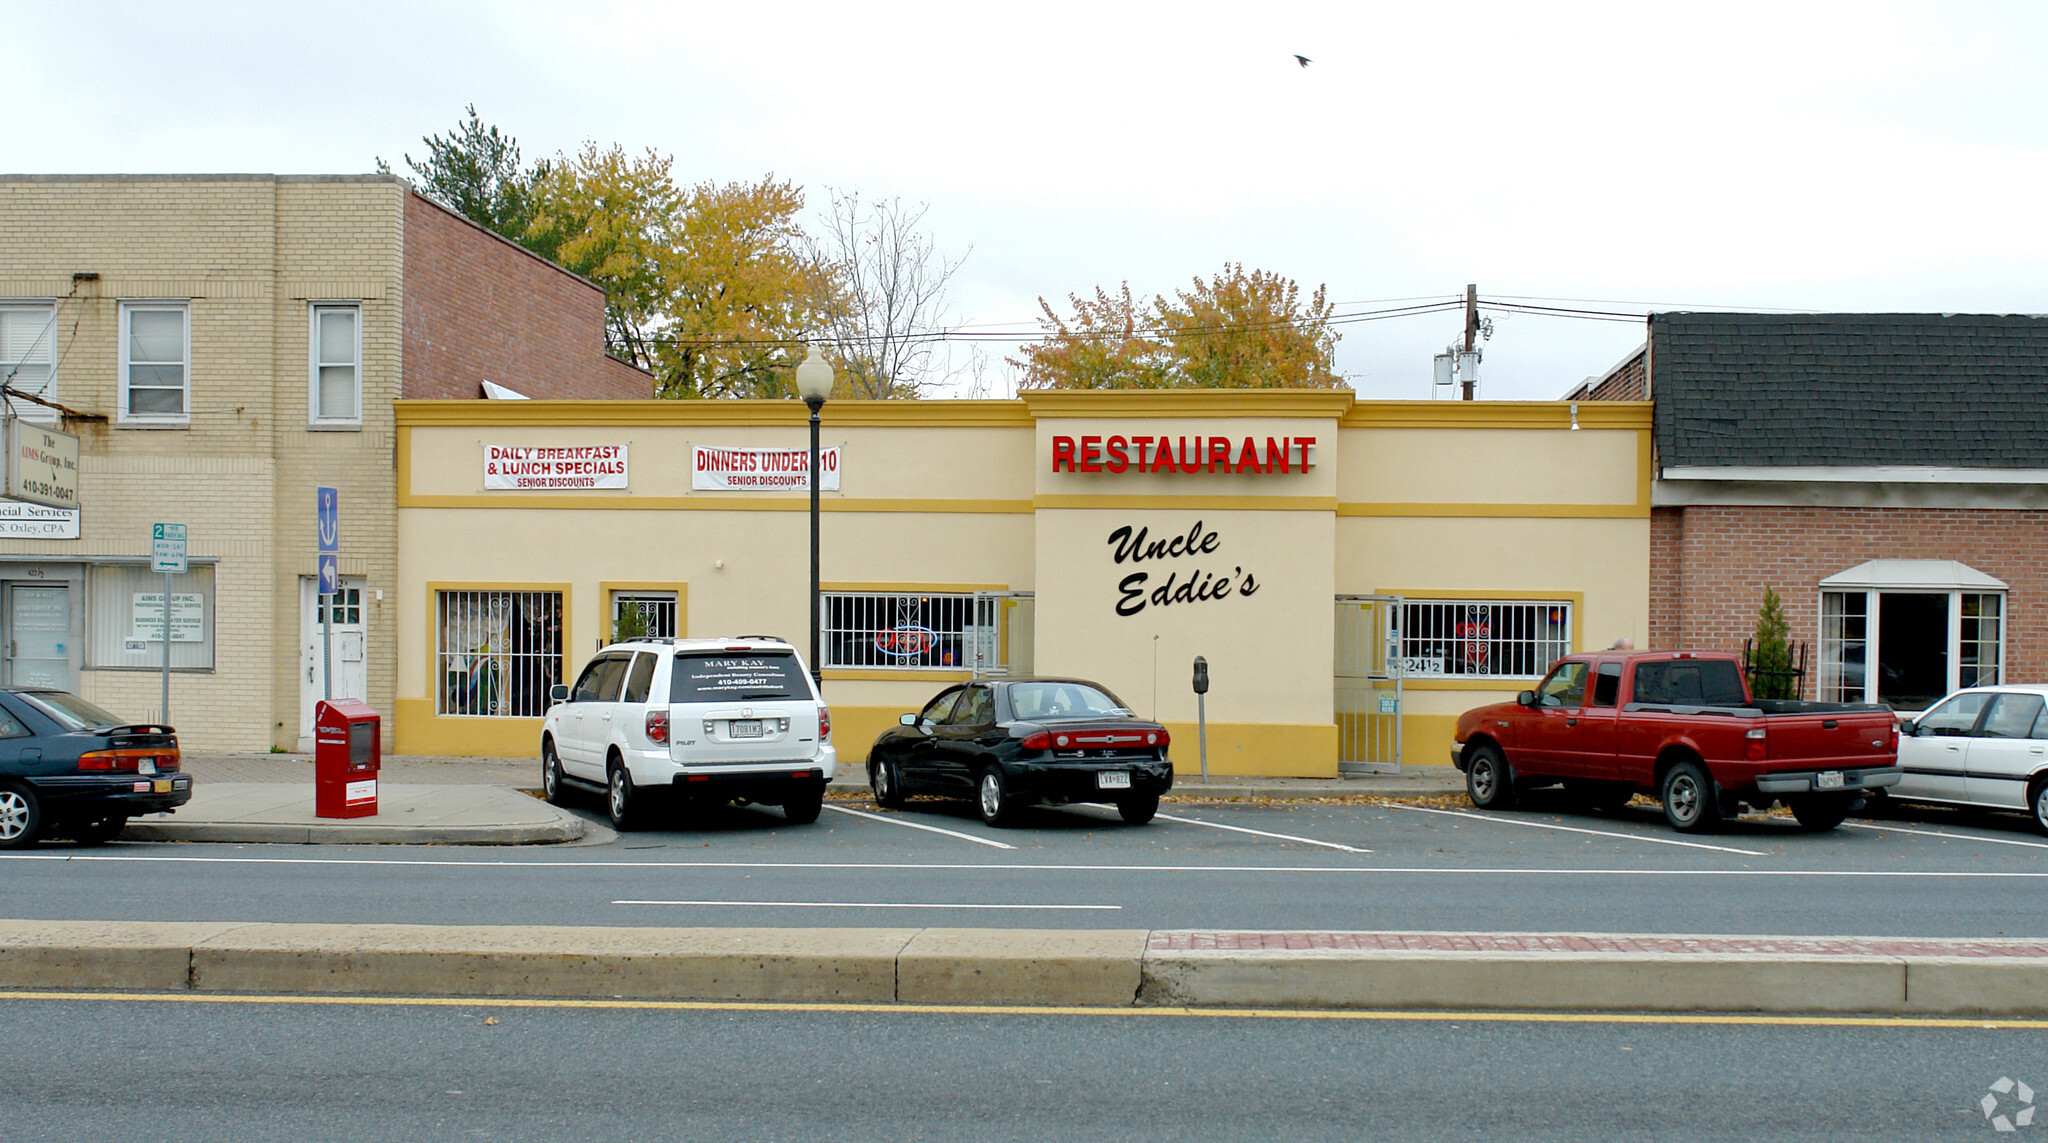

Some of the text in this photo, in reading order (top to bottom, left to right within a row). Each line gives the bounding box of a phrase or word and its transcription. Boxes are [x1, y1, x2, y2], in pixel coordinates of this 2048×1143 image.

[43, 434, 55, 448] The
[21, 445, 39, 461] AIMS
[64, 456, 77, 471] Inc.
[491, 446, 620, 460] DAILY BREAKFAST
[1052, 435, 1316, 474] RESTAURANT
[487, 461, 625, 475] & LUNCH SPECIALS
[697, 450, 837, 472] DINNERS UNDER 10
[517, 477, 595, 487] SENIOR DISCOUNTS
[727, 475, 807, 486] SENIOR DISCOUNTS
[23, 479, 74, 501] 410-391-0047
[28, 506, 73, 517] Services
[10, 523, 41, 536] Oxley,
[43, 524, 65, 533] CPA
[155, 525, 163, 538] 2
[1107, 520, 1221, 564] Uncle
[1115, 566, 1260, 617] Eddie's
[877, 628, 933, 654] OPEN
